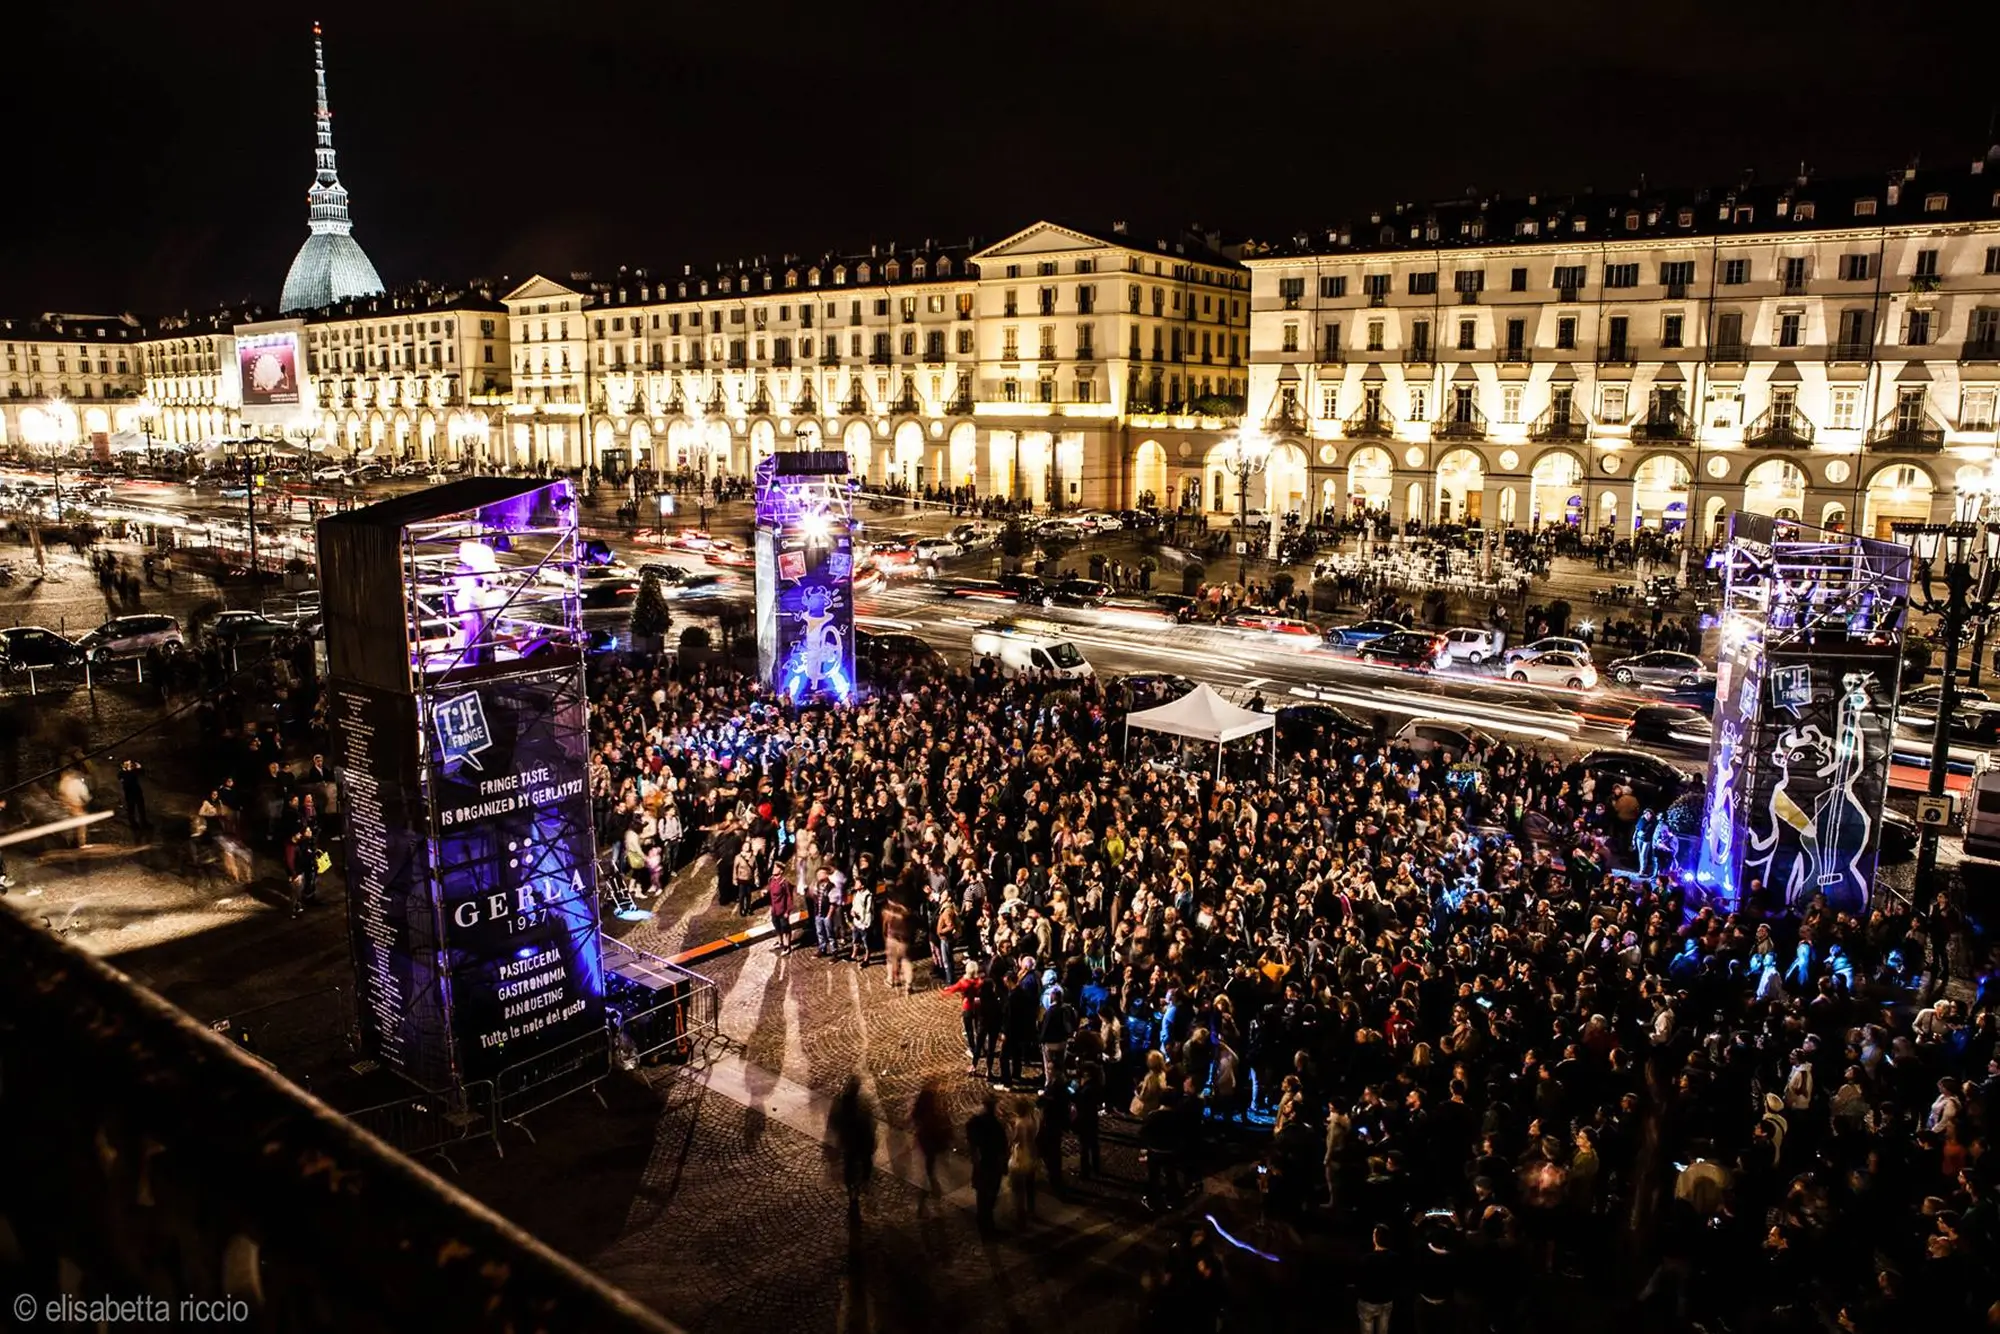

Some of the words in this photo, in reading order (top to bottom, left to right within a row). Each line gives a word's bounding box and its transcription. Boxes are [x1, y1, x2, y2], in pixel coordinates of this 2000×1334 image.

[452, 727, 485, 748] FRINGE
[480, 775, 518, 796] FRINGE
[520, 767, 550, 785] TASTE
[441, 811, 453, 826] IS
[455, 797, 516, 823] ORGANIZED
[518, 793, 531, 808] BY
[532, 778, 583, 805] GERLA1927
[454, 868, 586, 928] GERLA
[507, 908, 548, 934] 1927
[499, 947, 562, 980] PASTICCERIA
[498, 966, 567, 1001] GASTRONOMIA
[504, 987, 564, 1020] BANQUETING
[480, 1029, 509, 1049] Tutte
[510, 1025, 521, 1039] le
[522, 1017, 544, 1035] note
[546, 1009, 561, 1025] del
